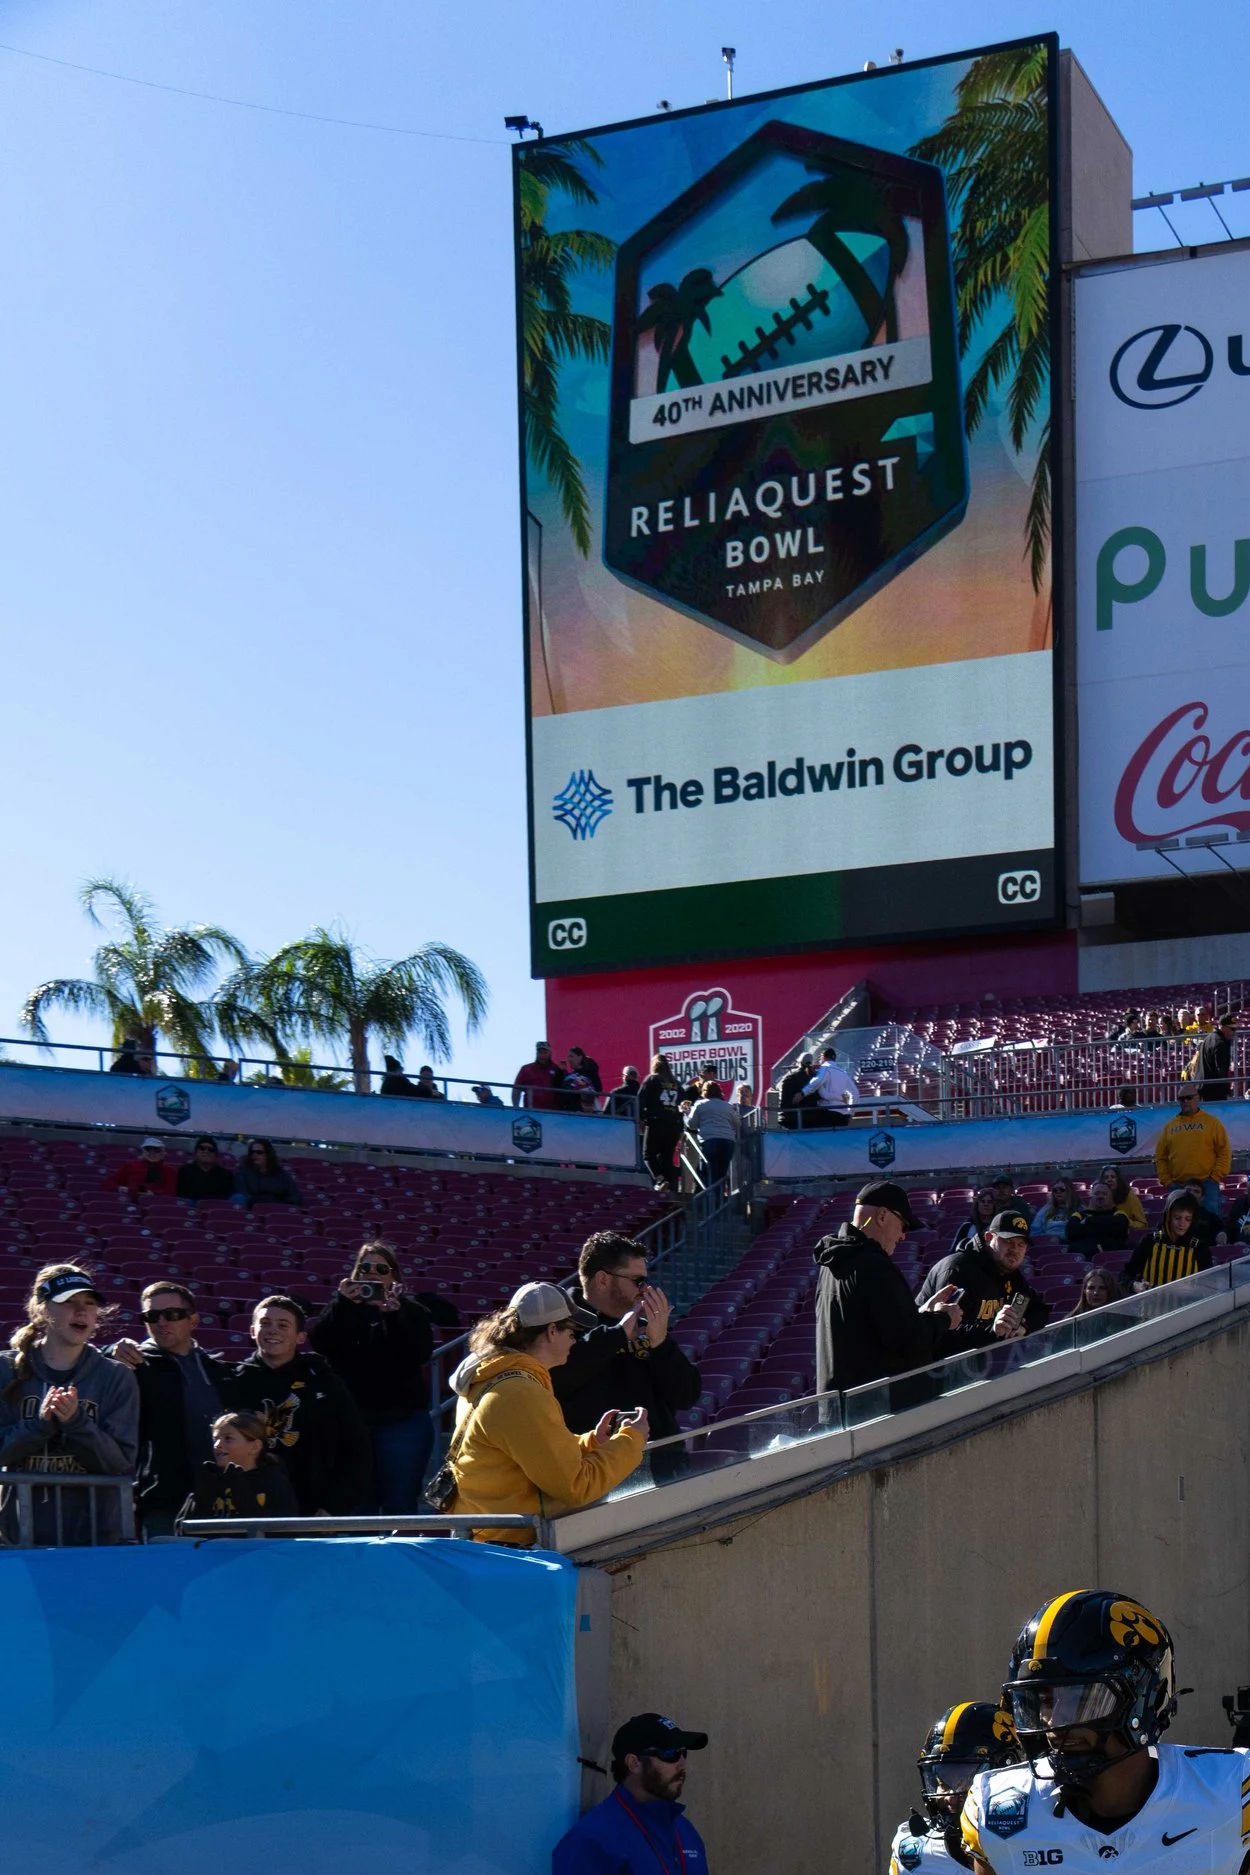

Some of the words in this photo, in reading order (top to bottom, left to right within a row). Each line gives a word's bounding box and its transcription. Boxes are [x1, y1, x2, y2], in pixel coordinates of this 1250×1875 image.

[652, 395, 703, 427] 40TH
[708, 355, 895, 417] ANNIVERSARY
[630, 456, 900, 538] RELIAQUEST
[725, 526, 825, 569] BOWL
[726, 578, 784, 598] TAMPA
[792, 570, 825, 588] BAY
[627, 773, 703, 814] The
[713, 747, 885, 805] Baldwin
[893, 738, 1033, 784] Group
[1000, 873, 1039, 902] CC
[551, 921, 585, 948] CC
[659, 1028, 686, 1039] 2002
[725, 1023, 752, 1033] 2020
[665, 1049, 706, 1062] SUPER
[709, 1046, 748, 1058] BOWL
[861, 1058, 894, 1069] 220-219
[1169, 1121, 1205, 1135] IOWA
